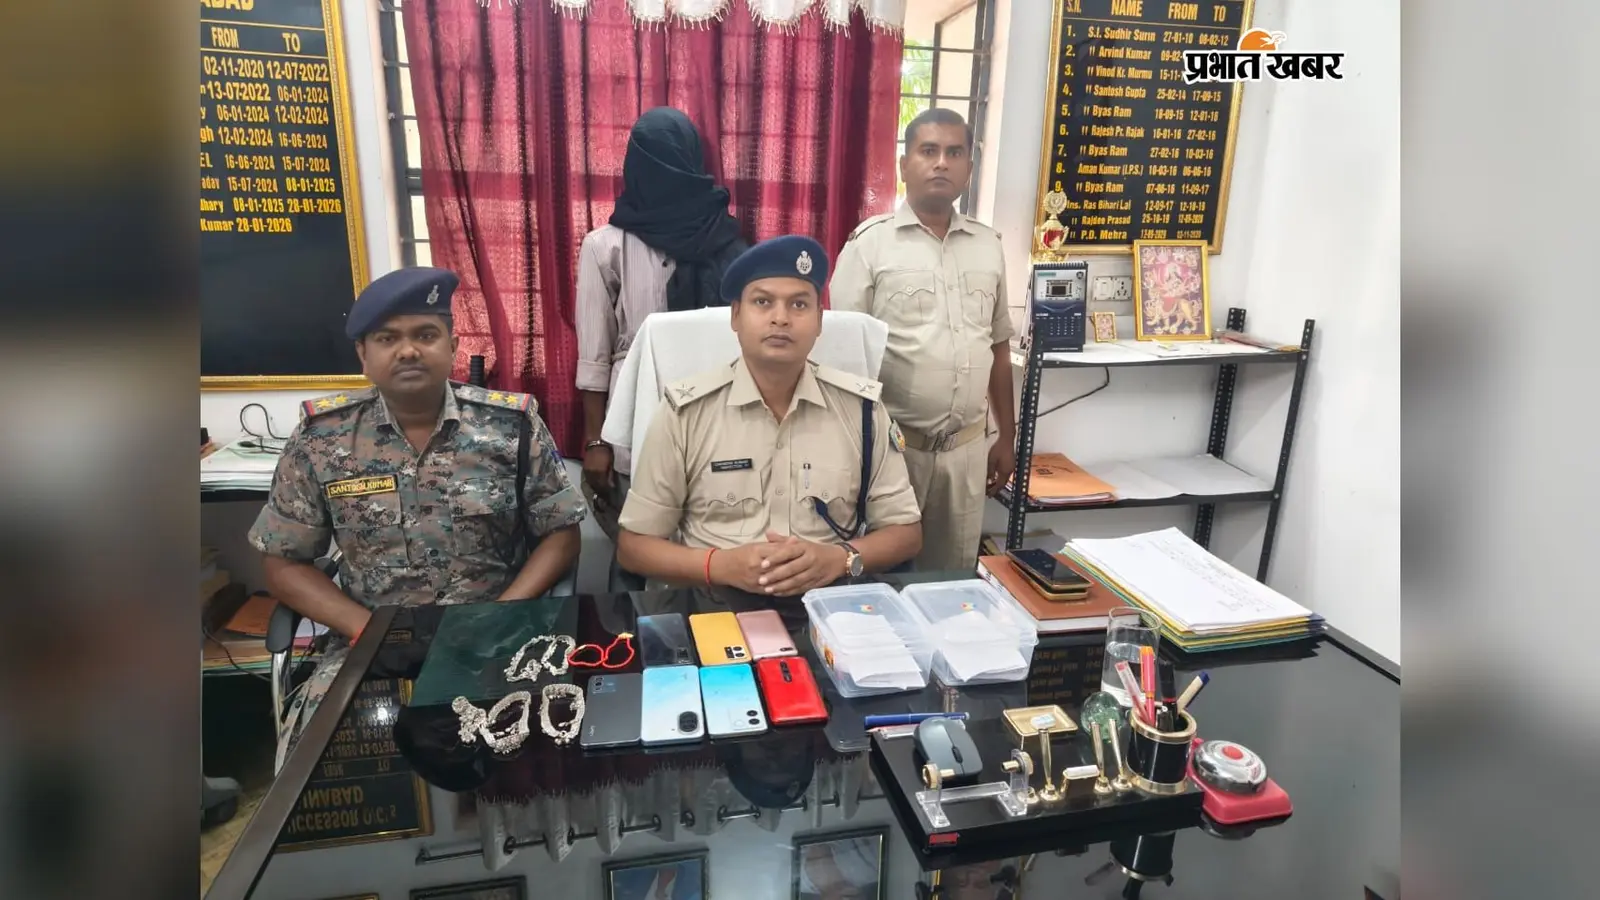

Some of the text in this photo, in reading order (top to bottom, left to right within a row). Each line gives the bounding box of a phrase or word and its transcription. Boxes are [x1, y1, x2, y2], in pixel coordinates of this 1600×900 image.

[1111, 0, 1143, 17] NAME
[1168, 3, 1198, 21] FROM
[1213, 5, 1227, 22] TO
[210, 27, 301, 53] FROM TO
[1067, 25, 1076, 38] 1.
[1088, 26, 1102, 39] S.I.
[1104, 27, 1133, 41] Sudhir
[1065, 45, 1076, 58] 2.
[1099, 46, 1125, 59] Arvind
[1126, 47, 1152, 60] Kumar
[203, 56, 330, 82] 02-11-2020 12-07-2022
[1064, 64, 1074, 77] 3.
[1095, 65, 1116, 78] Vinod
[1127, 67, 1153, 80] Murmu
[207, 81, 272, 102] 13-07-2022
[277, 85, 329, 105] 06-01-2024
[1062, 84, 1073, 97] 4.
[1094, 85, 1125, 98] Santosh
[1125, 86, 1147, 99] Gupta
[216, 104, 270, 123] 06-01-2024
[275, 104, 329, 125] 12-02-2024
[1060, 105, 1071, 117] 5.
[1092, 105, 1112, 118] Byas
[1113, 106, 1132, 118] Ram
[217, 126, 274, 148] 12-02-2024
[278, 132, 328, 149] 16-06-2024
[1059, 124, 1069, 137] 6.
[1091, 125, 1115, 139] Rajesh
[1125, 127, 1145, 139] Rajak
[1057, 145, 1067, 157] 7.
[1088, 145, 1108, 157] Byas
[1109, 145, 1128, 157] Ram
[225, 153, 275, 171] 16-06-2024
[282, 155, 331, 173] 15-07-2024
[1056, 162, 1065, 174] 8.
[1077, 163, 1098, 175] Aman
[1098, 164, 1122, 175] Kumar
[227, 176, 279, 193] 15-07-2024
[285, 177, 336, 193] 08-01-2025
[1054, 180, 1064, 192] 9.
[1085, 182, 1104, 194] Byas
[1105, 182, 1124, 193] Ram
[232, 196, 285, 213] 08-01-2025
[286, 198, 342, 214] 28-01-2026
[1083, 200, 1097, 211] Ras
[1098, 200, 1120, 211] Bihari
[200, 217, 293, 233] Kumar 28-01-2026
[1107, 214, 1131, 226] Prasad
[1100, 229, 1128, 240] Mehra
